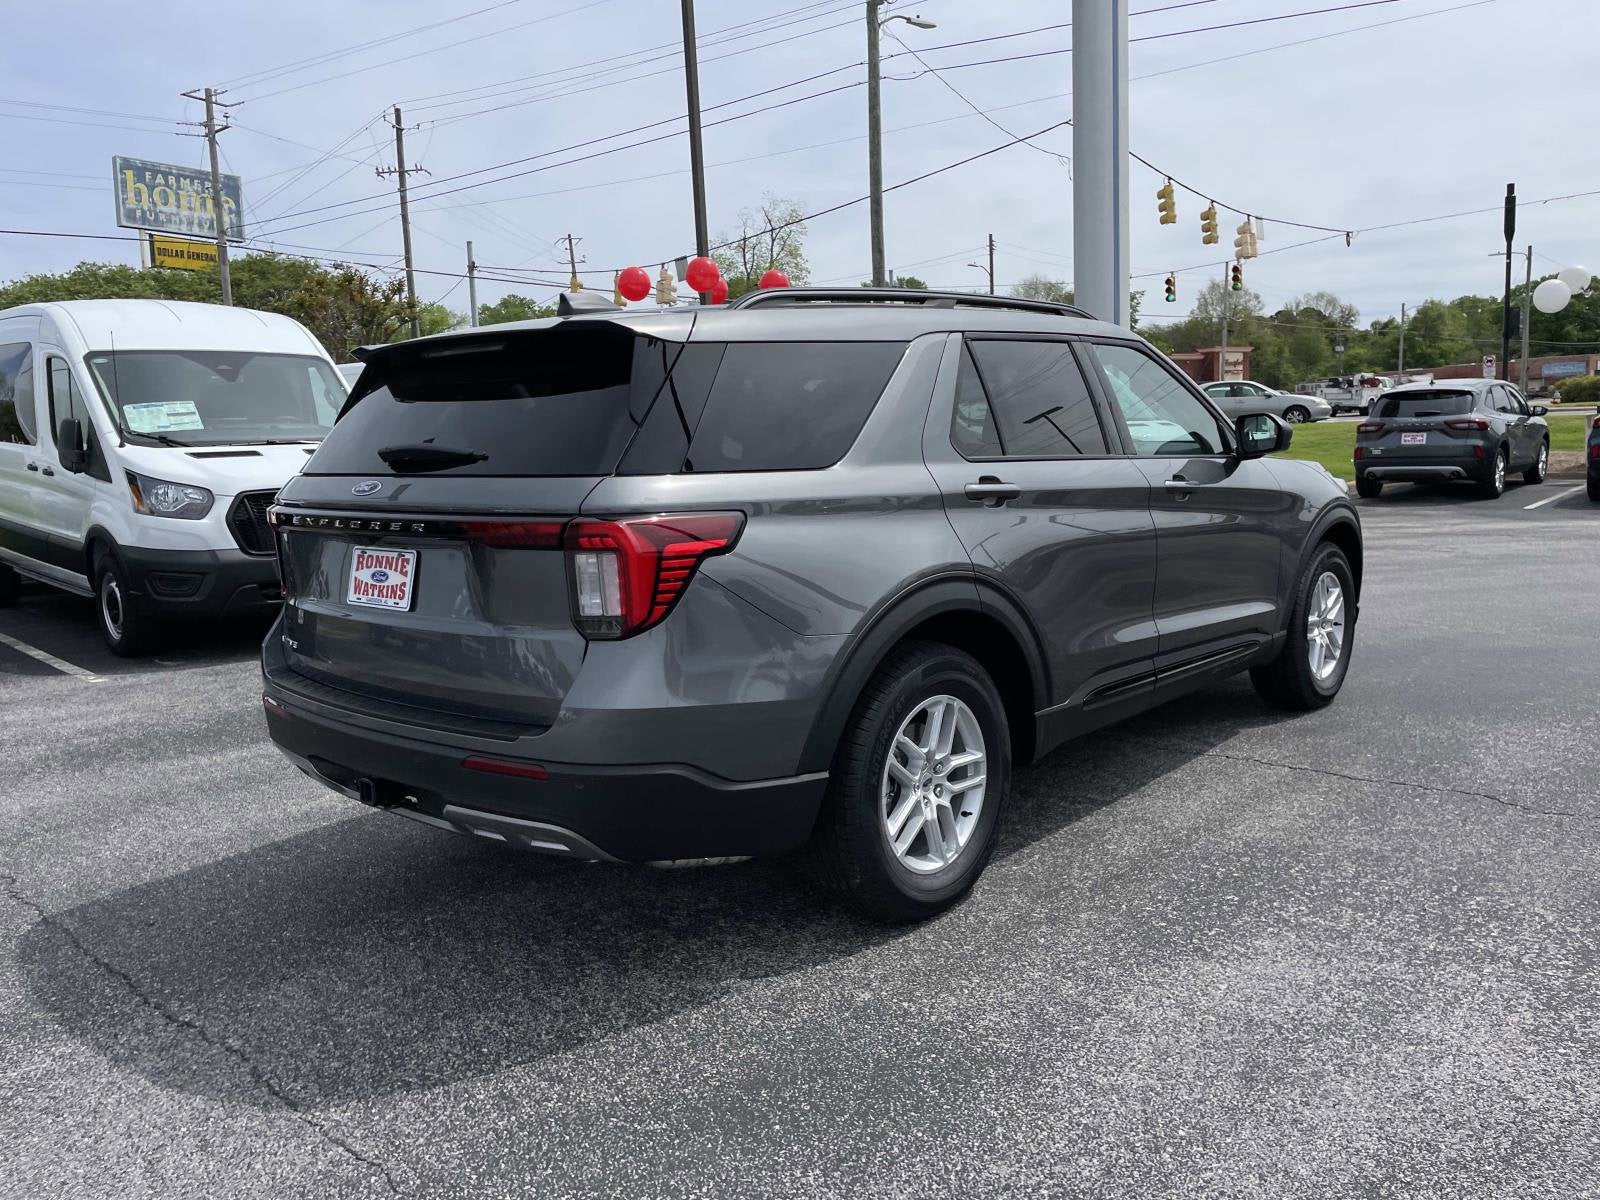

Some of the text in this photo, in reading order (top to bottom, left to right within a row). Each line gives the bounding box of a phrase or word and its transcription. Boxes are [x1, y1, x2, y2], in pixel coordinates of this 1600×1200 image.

[145, 171, 222, 193] FARMER
[156, 247, 185, 259] DOLLAR
[292, 514, 425, 532] EXPLORER
[355, 553, 410, 578] RONNIE
[353, 576, 407, 600] WATKINS
